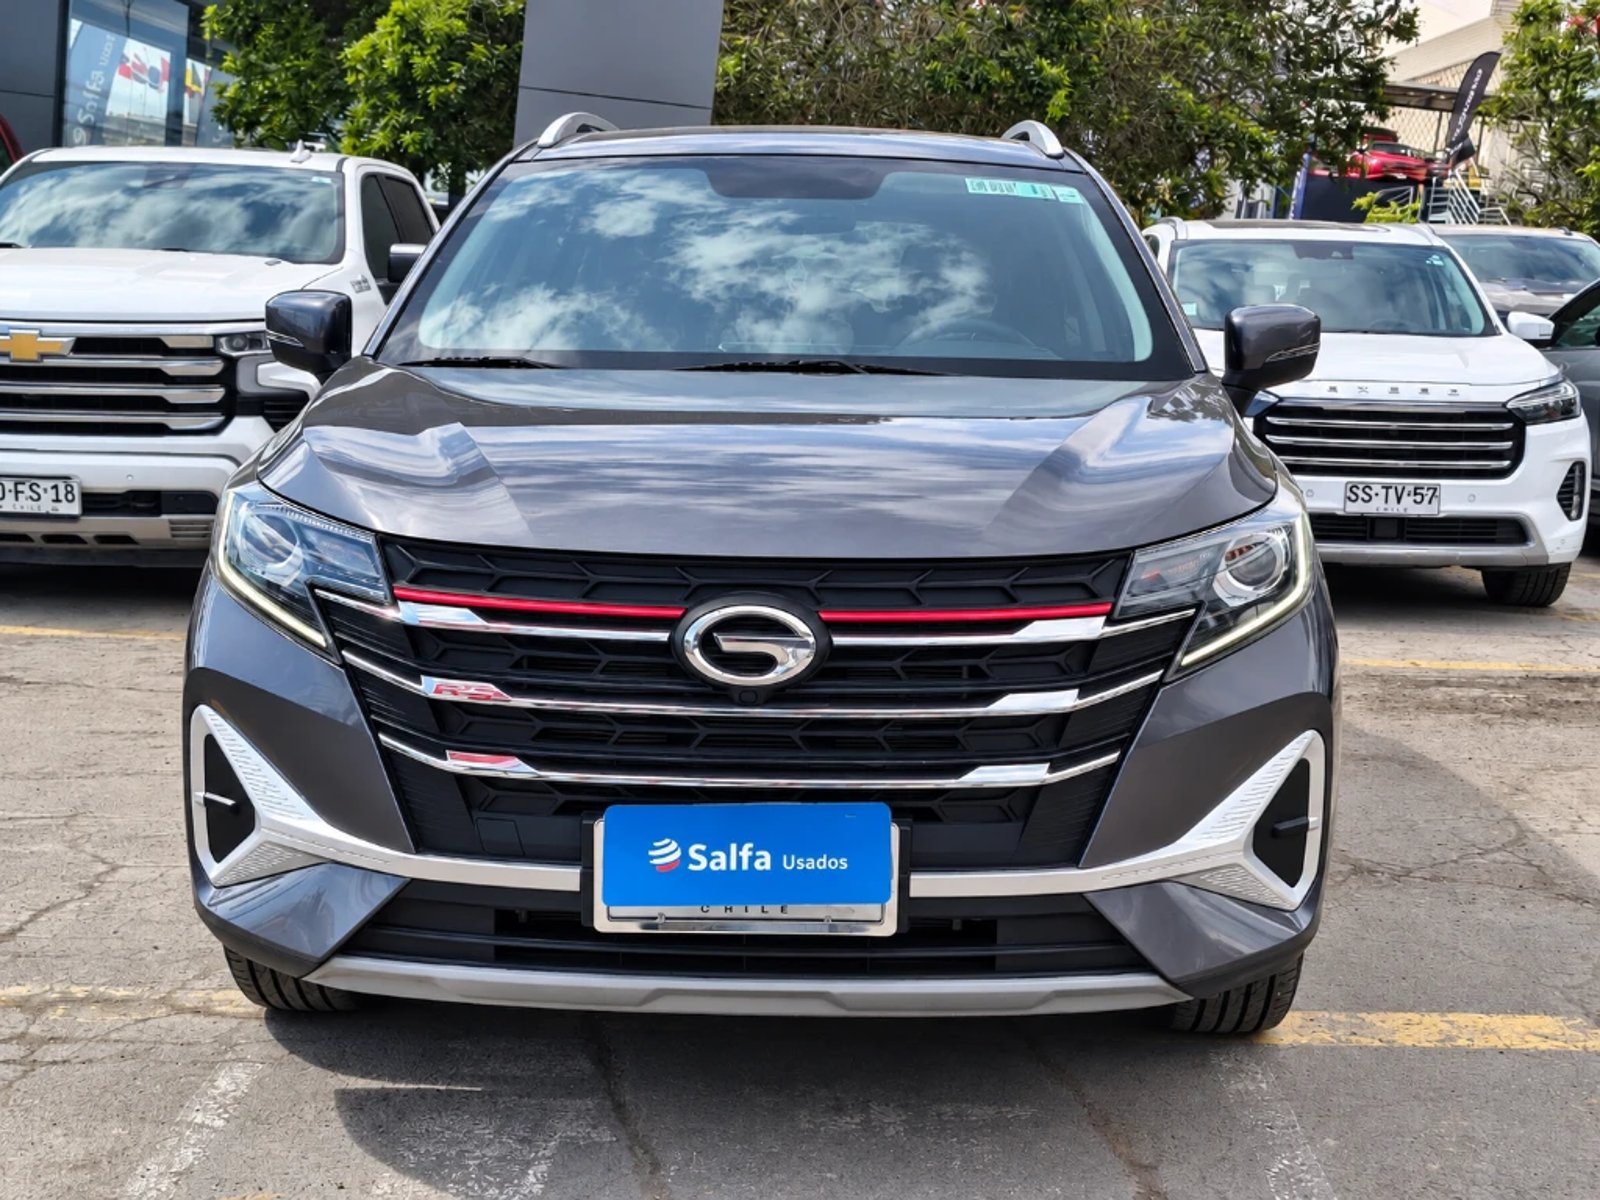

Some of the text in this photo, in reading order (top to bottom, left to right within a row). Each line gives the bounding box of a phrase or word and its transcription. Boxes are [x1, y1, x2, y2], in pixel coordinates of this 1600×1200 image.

[687, 843, 848, 871] Salfa Usados
[700, 905, 788, 914] CHILE
